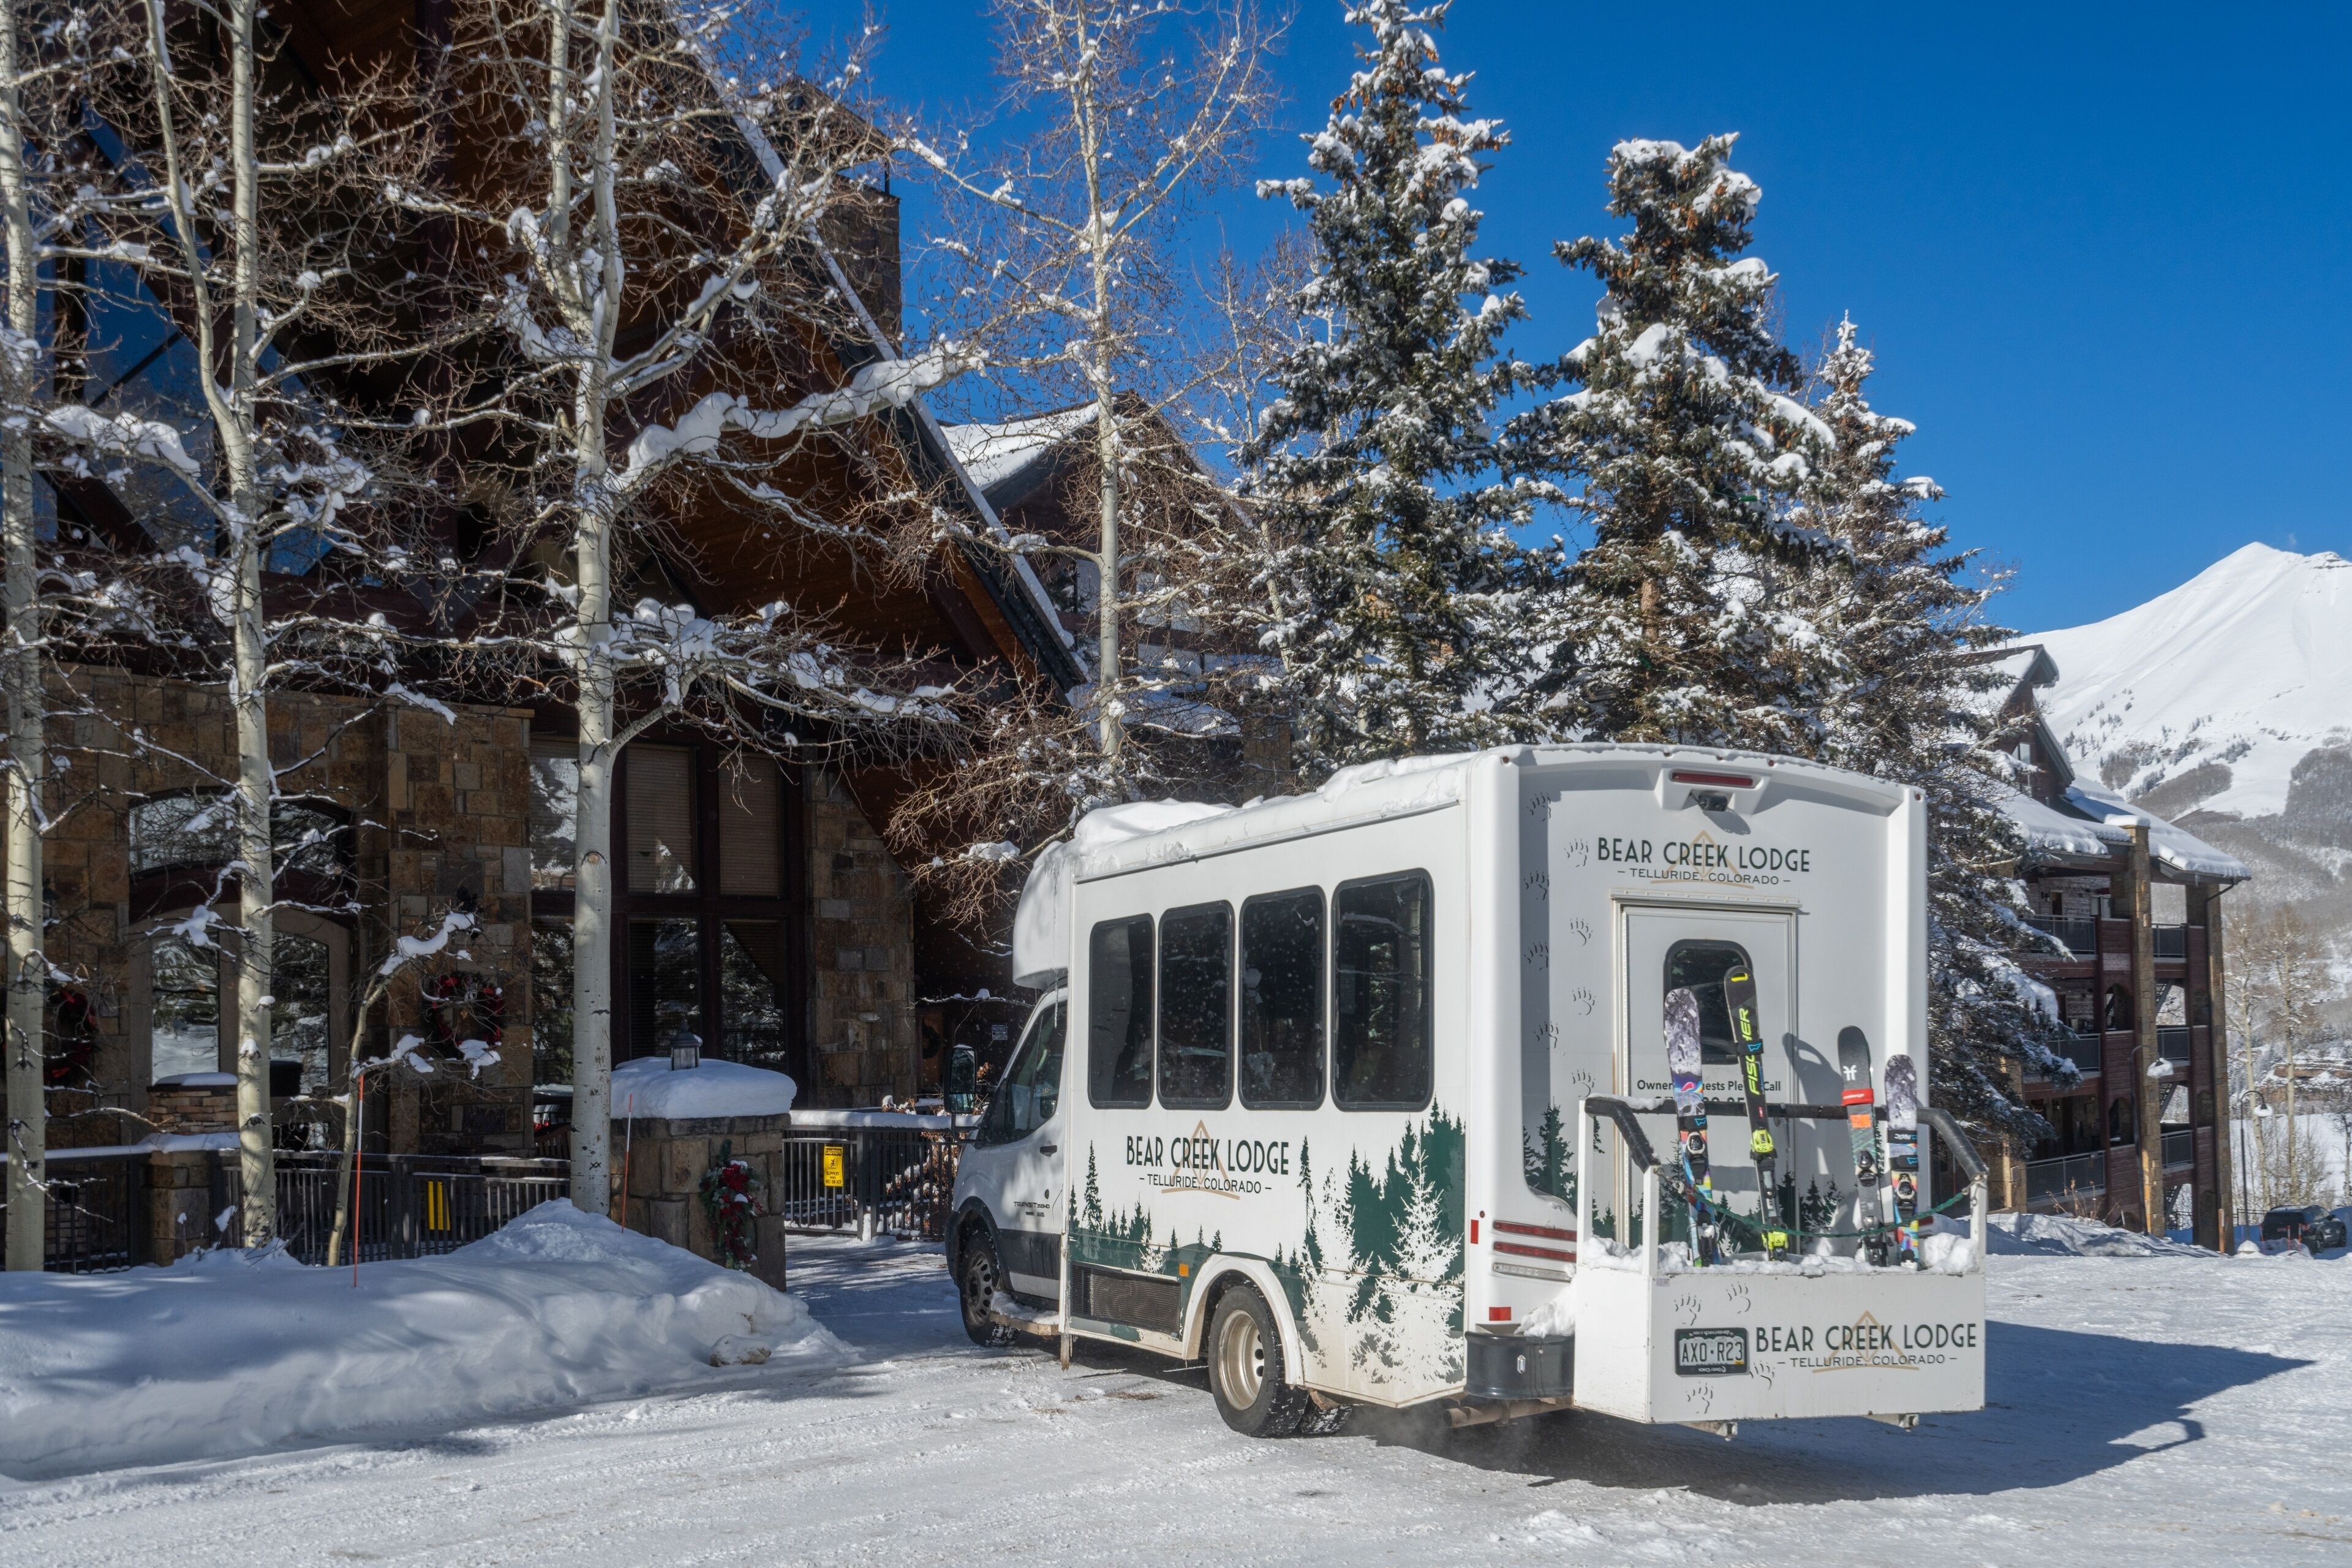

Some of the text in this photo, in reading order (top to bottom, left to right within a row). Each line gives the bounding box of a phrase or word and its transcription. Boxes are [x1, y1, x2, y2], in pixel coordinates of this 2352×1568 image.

[1598, 837, 1809, 872] BEAR CREEK LODGE
[1630, 869, 1779, 884] TELLURIDE, COLORADO
[1764, 1081, 1781, 1091] Call
[1126, 1136, 1289, 1175] BEAR CREEK LODGE
[1147, 1174, 1261, 1193] TELLURIDE, COLORADO
[1756, 1323, 1976, 1352] BEAR CREEK LODGE
[1790, 1354, 1945, 1367] TELLURIDE, COLORADO
